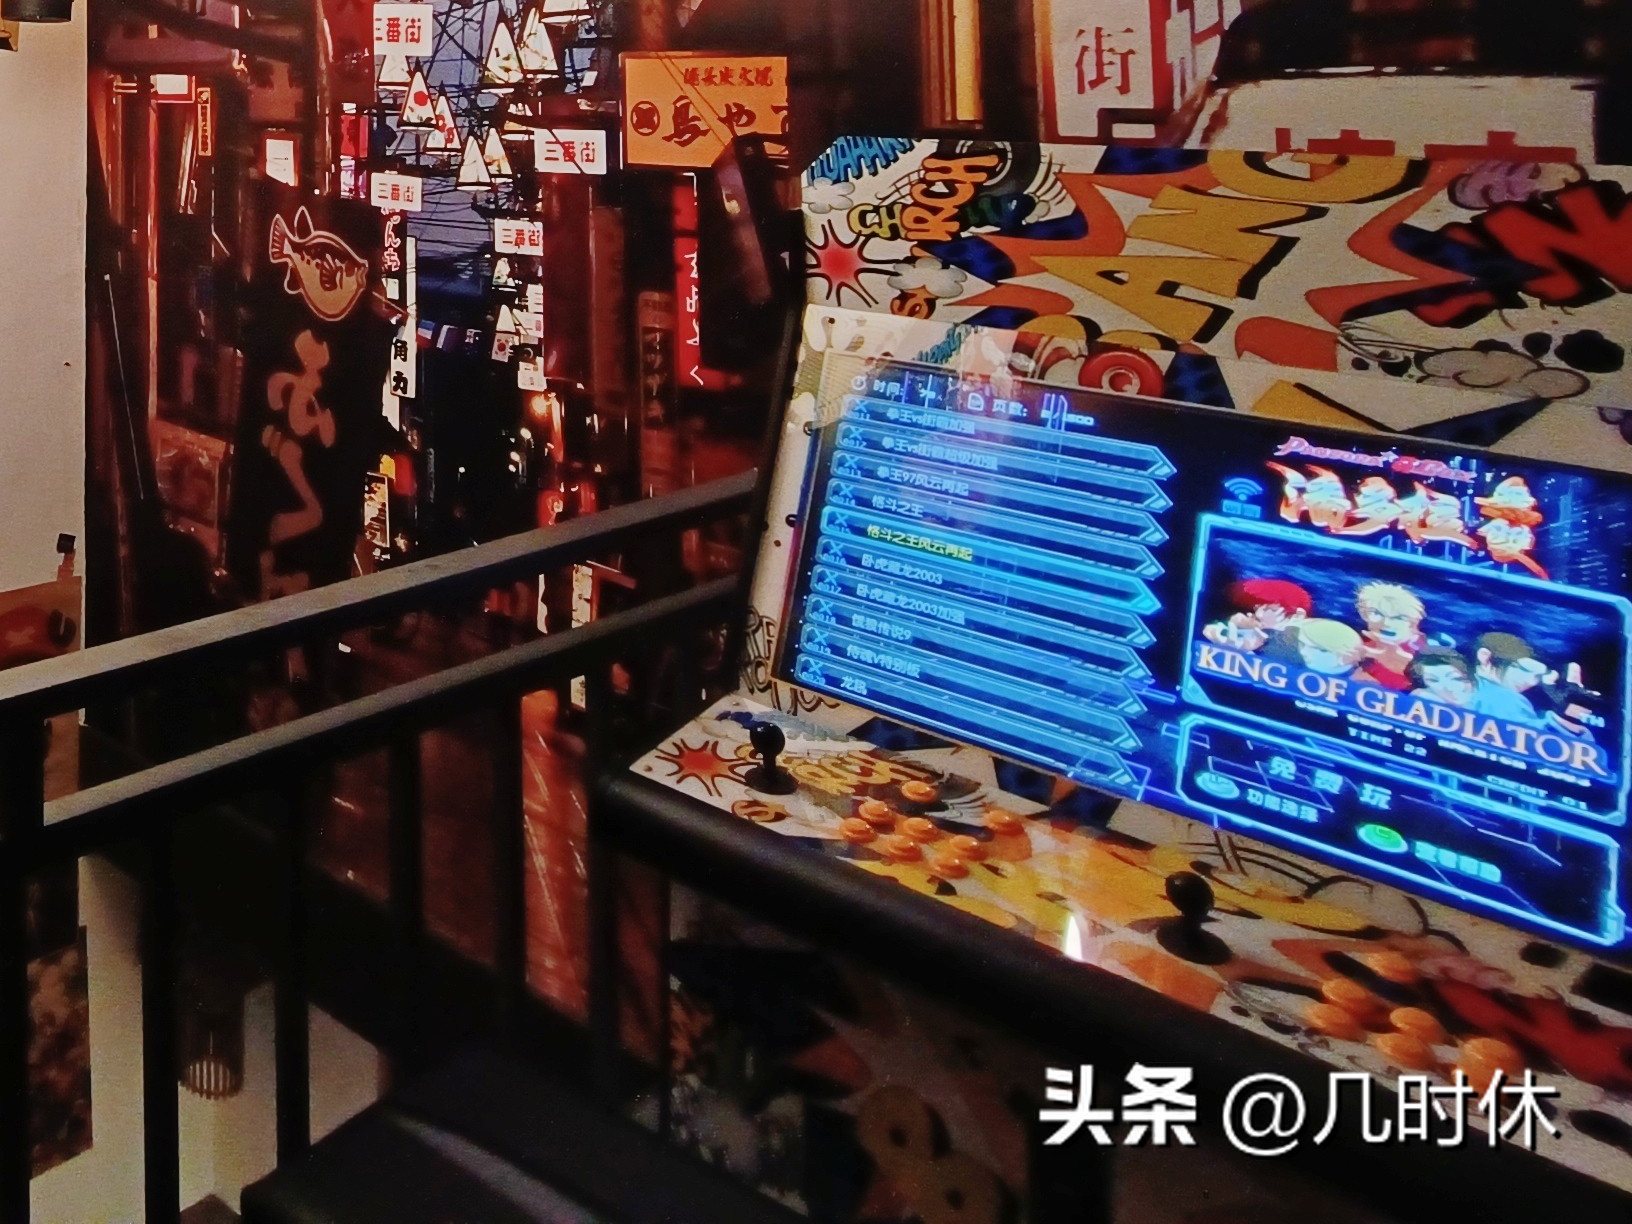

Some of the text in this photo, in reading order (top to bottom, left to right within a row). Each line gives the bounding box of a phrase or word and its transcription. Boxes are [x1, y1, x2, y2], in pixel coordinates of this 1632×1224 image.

[544, 141, 596, 165] 三番街
[378, 183, 414, 203] 三番街
[1198, 643, 1608, 776] KING OF GLADIATOR
